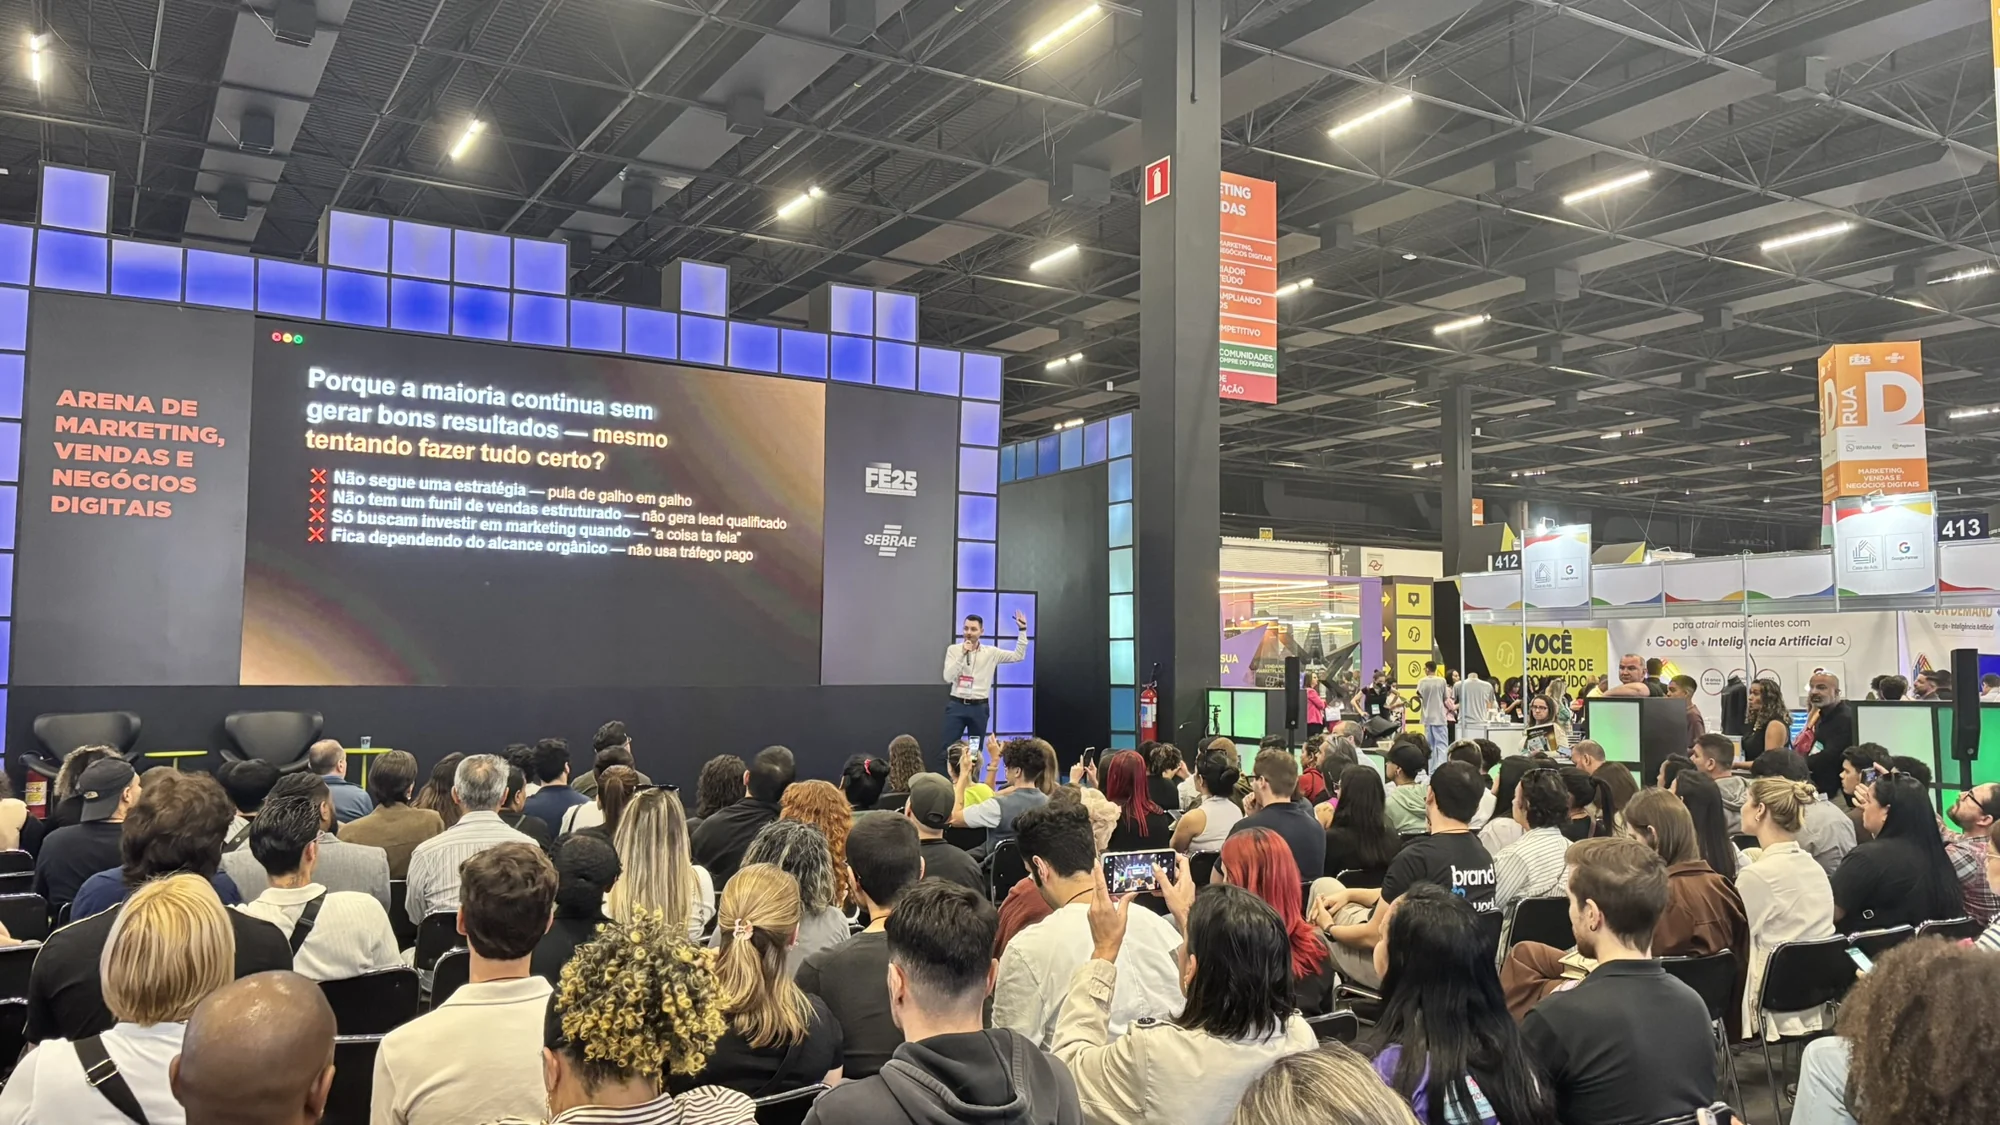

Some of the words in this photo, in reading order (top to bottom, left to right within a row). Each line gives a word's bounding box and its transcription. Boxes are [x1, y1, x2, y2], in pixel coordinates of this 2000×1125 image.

[1248, 252, 1272, 262] DIGITAIS
[1220, 324, 1261, 337] MPETITIVO
[1219, 348, 1273, 363] COMUNIDADES
[1249, 360, 1274, 369] PEQUENO
[55, 389, 155, 414] ARENA
[162, 398, 197, 417] DE
[308, 367, 396, 398] Porque
[401, 381, 416, 398] a
[421, 382, 505, 406] maioria
[511, 391, 605, 416] continua
[609, 402, 654, 420] sem
[1842, 385, 1858, 424] RUA
[1865, 371, 1923, 426] D
[55, 415, 225, 448] MARKETING,
[306, 401, 373, 424] gerar
[378, 403, 437, 428] bons
[442, 414, 559, 439] resultados
[592, 427, 668, 449] mesmo
[53, 441, 170, 466] VENDAS
[176, 451, 194, 468] E
[305, 429, 413, 456] tentando
[418, 438, 476, 461] fazer
[481, 443, 531, 464] tudo
[537, 450, 606, 470] certo?
[52, 468, 197, 494] NEGÓCIOS
[865, 467, 918, 490] FE25
[1858, 467, 1904, 475] MARKETING,
[334, 469, 366, 486] Não
[369, 475, 416, 490] segue
[419, 478, 452, 491] uma
[455, 480, 526, 498] estratégia
[548, 486, 575, 501] pula
[579, 487, 596, 500] de
[599, 489, 634, 504] galho
[636, 494, 656, 504] em
[658, 494, 692, 508] galho
[1846, 481, 1885, 489] NEGÓCIOS
[51, 495, 172, 518] DIGITAIS
[333, 489, 365, 505] Não
[368, 492, 397, 507] tem
[401, 496, 425, 508] um
[428, 496, 462, 511] funil
[465, 498, 484, 512] de
[487, 501, 539, 515] vendas
[541, 504, 621, 520] estruturado
[641, 509, 666, 522] não
[668, 513, 695, 526] gera
[698, 512, 724, 526] lead
[726, 516, 787, 530] qualificado
[331, 509, 354, 523] Só
[356, 510, 418, 527] buscam
[421, 513, 477, 530] investir
[479, 521, 502, 531] em
[505, 520, 576, 538] marketing
[579, 525, 631, 538] quando
[666, 529, 698, 541] coisa
[701, 530, 713, 542] ta
[1942, 518, 1981, 538] 413
[331, 528, 365, 543] Fica
[368, 529, 462, 547] dependendo
[465, 534, 485, 548] do
[488, 536, 543, 551] alcance
[546, 540, 608, 555] orgânico
[627, 544, 652, 556] não
[655, 546, 677, 558] usa
[680, 545, 721, 562] tráfego
[724, 550, 753, 563] pago
[864, 534, 917, 548] SEBRAE
[1495, 553, 1519, 568] 412
[1672, 621, 1694, 631] para
[1695, 620, 1721, 629] atrair
[1721, 619, 1745, 629] mais
[1748, 618, 1785, 628] clientes
[1788, 619, 1811, 628] com
[1951, 622, 1976, 631] Inteligência
[1977, 623, 1994, 631] Artificial
[1521, 629, 1572, 655] VOCÊ
[1655, 635, 1698, 650] Google
[1707, 636, 1776, 650] Inteligncia
[1779, 635, 1833, 647] Artificial
[1220, 654, 1239, 664] SUA
[1525, 657, 1576, 672] CRIADOR
[1579, 658, 1594, 671] DE
[1450, 863, 1495, 887] brand
